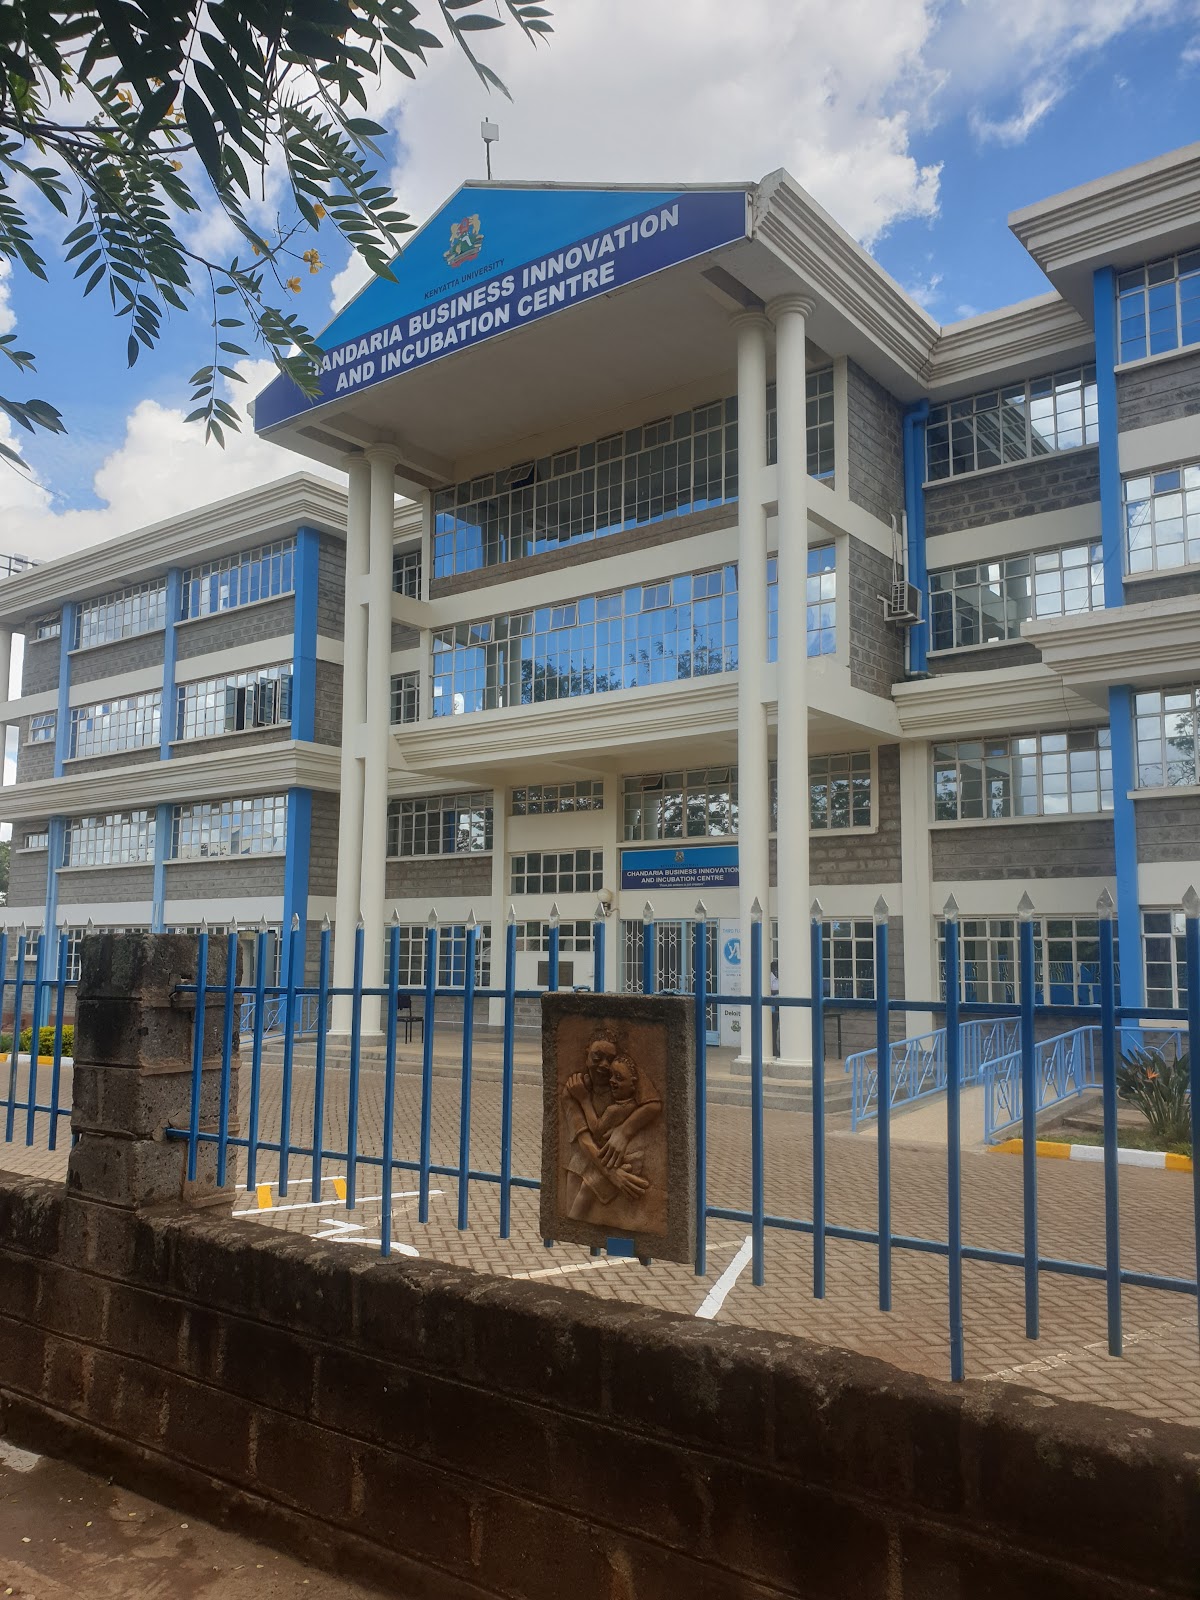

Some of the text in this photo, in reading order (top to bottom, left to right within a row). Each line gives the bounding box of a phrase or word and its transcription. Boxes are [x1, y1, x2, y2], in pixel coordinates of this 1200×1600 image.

[308, 204, 679, 377] HANDARIA BUSINESS INNOVATION
[424, 258, 505, 300] KENYATTA UNIVERSITY
[335, 260, 615, 392] AND INCUBATION CENTRE
[626, 869, 664, 877] CHANDARIA
[664, 868, 697, 876] BUSINESS
[696, 874, 724, 882] CENTRE
